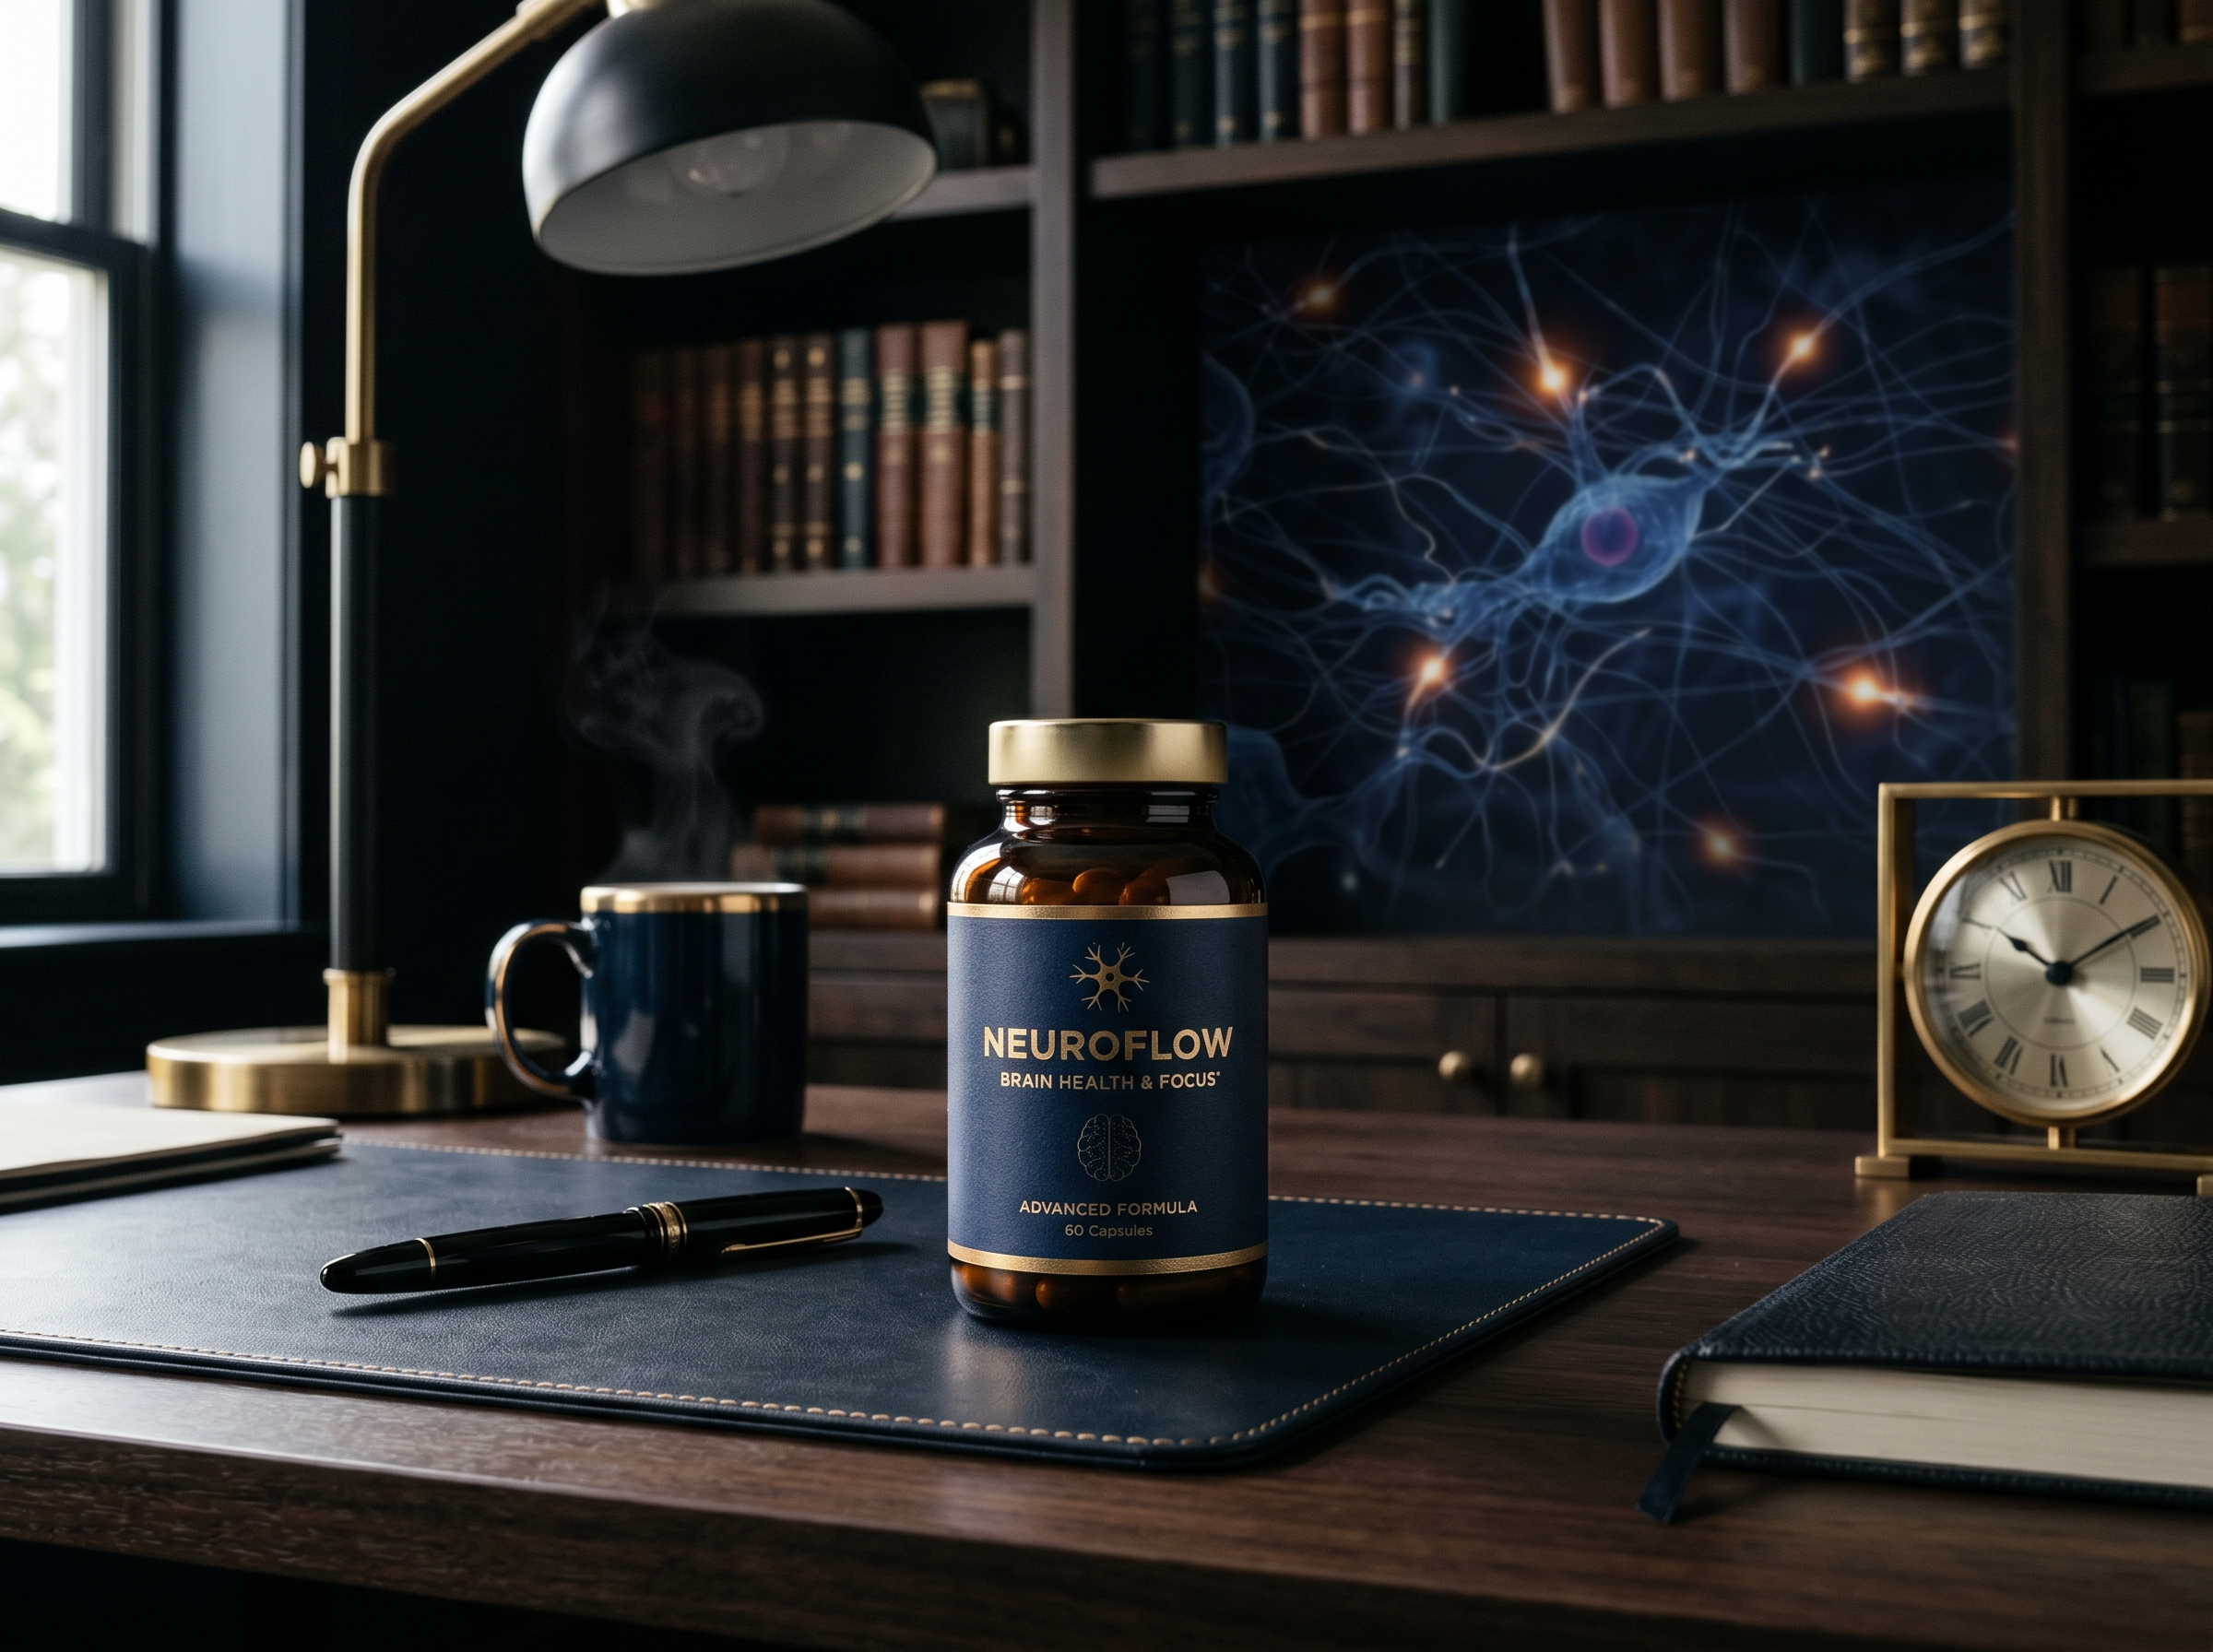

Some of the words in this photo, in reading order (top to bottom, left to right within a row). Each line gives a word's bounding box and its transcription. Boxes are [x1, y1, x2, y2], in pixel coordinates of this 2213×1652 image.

[983, 1025, 1234, 1062] NEUROFLOW
[1000, 1070, 1053, 1090] BRAIN
[1059, 1074, 1134, 1091] HEALTH
[1140, 1075, 1154, 1091] &
[1019, 1199, 1112, 1217] ADVANCED
[1117, 1199, 1199, 1216] FORMULA
[1064, 1223, 1084, 1237] 60
[1088, 1223, 1154, 1239] Capsules
